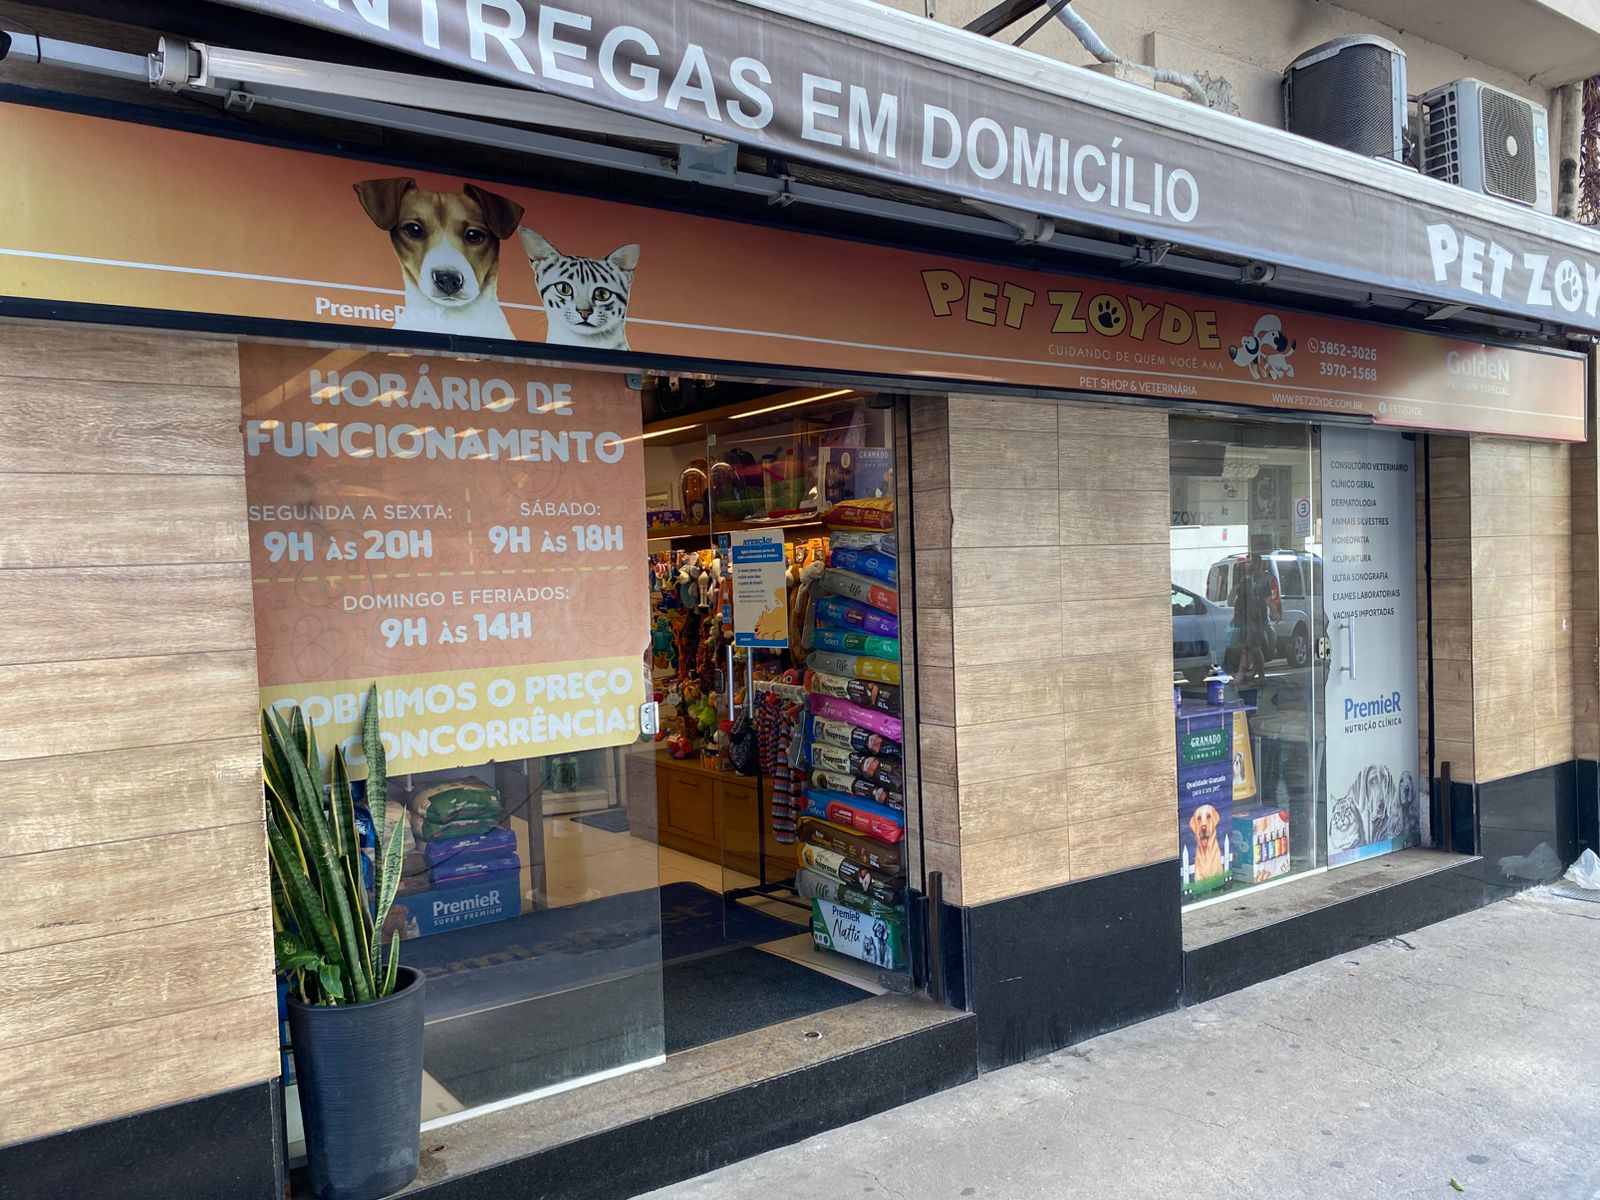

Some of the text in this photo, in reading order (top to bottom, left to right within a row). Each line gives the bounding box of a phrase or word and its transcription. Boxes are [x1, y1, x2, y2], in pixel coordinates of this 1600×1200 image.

[801, 73, 898, 159] EM
[921, 103, 1200, 223] DOMICÍLIO
[1427, 223, 1513, 299] PET
[921, 269, 1222, 350] PET ZOYDE
[1048, 344, 1224, 371] CUIDANDO DE QUEM VOCÊ AMA
[1320, 341, 1377, 361] 3852-3026
[1320, 362, 1377, 381] 3970-1568
[1446, 350, 1510, 382] GoldeN
[310, 363, 574, 416] HORÁRIO DE
[1079, 376, 1198, 396] PET SHOP & VETERINÁRIA
[1271, 392, 1363, 410] WWW.PETZOYDE.COM.BR
[245, 419, 625, 464] FUNCIONAMENTO
[1330, 460, 1409, 472] CONSULTÓRIO VETERINÁRIO
[1331, 479, 1375, 489] CLÍNICO GERAL
[248, 503, 453, 521] SEGUNDA A SEXTA:
[520, 499, 601, 517] SÁBADO:
[1331, 498, 1377, 508] DERMATOLOGIA
[1331, 517, 1389, 526] ANIMAIS SILVESTRES
[263, 529, 433, 562] 9H ÀS 20H
[488, 525, 624, 554] 9H ÀS 18H
[1332, 535, 1370, 545] HOMEOPATIA
[1332, 554, 1372, 564] ACUPUNTURA
[1332, 572, 1389, 583] ULTRA SONOGRAFIA
[343, 586, 570, 611] DOMINGO E FERIADOS:
[1332, 589, 1401, 601] EXAMES LABORATORIAIS
[1333, 608, 1395, 620] VACINAS IMPORTADAS
[381, 611, 532, 648] 9H ÀS 14H
[487, 678, 516, 708] O
[525, 667, 634, 705] PREÇO
[1344, 691, 1402, 720] PremieR
[824, 727, 849, 742] Supreme
[1344, 717, 1402, 734] NUTRIÇÃO CLÍNICA
[1190, 734, 1222, 748] GRANADO
[1190, 752, 1209, 760] LINHA
[1186, 777, 1209, 790] Qualidade
[814, 857, 838, 875] Supreme
[433, 889, 501, 917] PremieR
[433, 907, 502, 927] SUPER PREMIUM
[832, 905, 861, 922] PremieR
